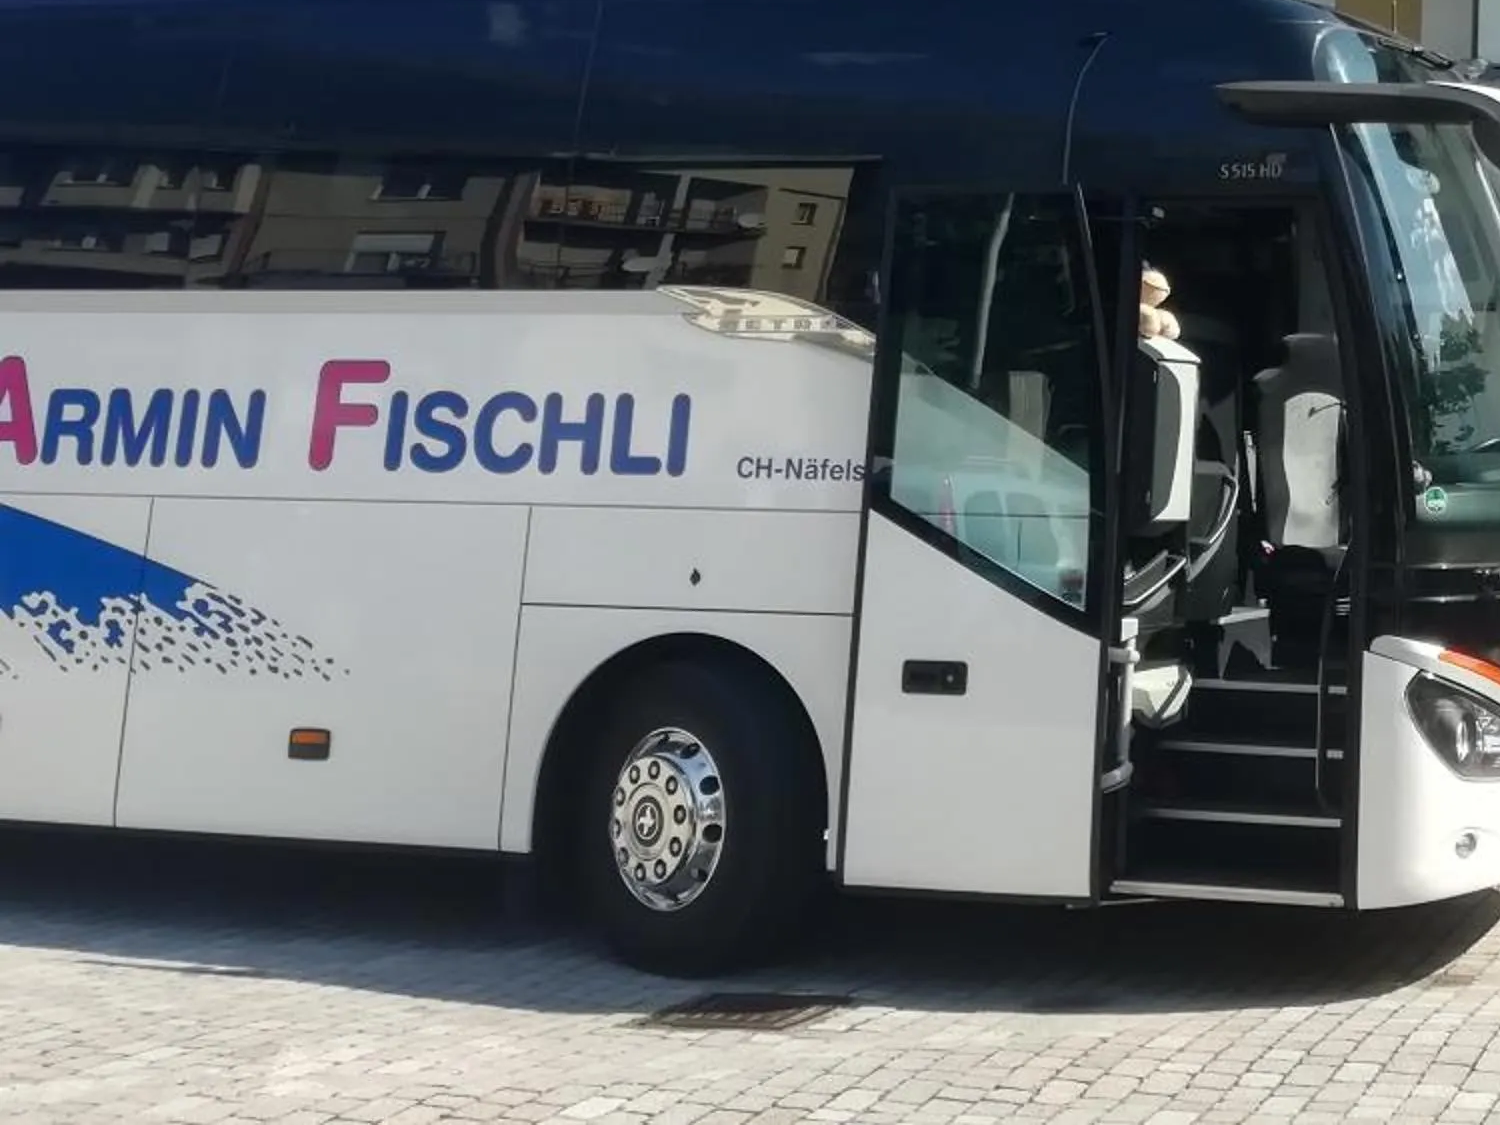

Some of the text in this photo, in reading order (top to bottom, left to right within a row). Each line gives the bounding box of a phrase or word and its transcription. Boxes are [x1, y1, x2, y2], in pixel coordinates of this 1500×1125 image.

[1220, 162, 1283, 180] S 515 HD
[0, 354, 692, 477] ARMIN FISCHLI
[736, 456, 866, 482] CH-Näfels
